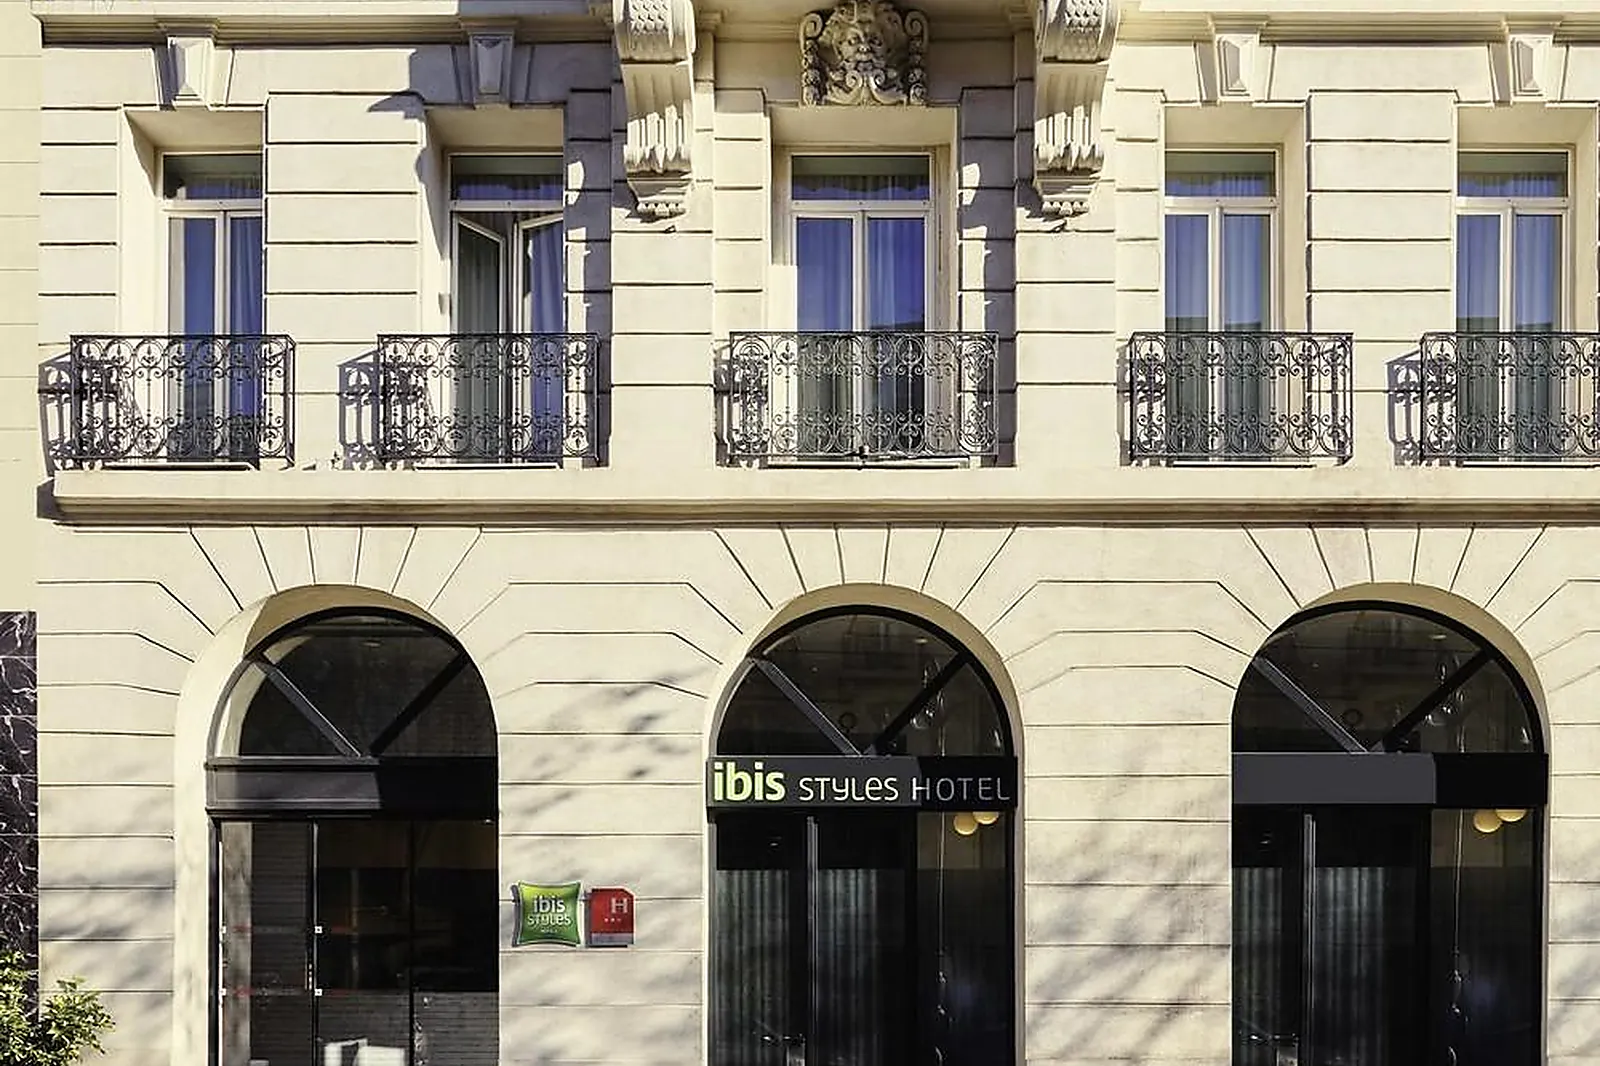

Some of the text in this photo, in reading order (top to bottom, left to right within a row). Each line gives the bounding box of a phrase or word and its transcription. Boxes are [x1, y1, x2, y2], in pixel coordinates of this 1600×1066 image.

[713, 761, 786, 802] ibis
[911, 777, 1011, 801] HOTEL
[533, 895, 566, 913] ibis
[611, 898, 628, 914] H
